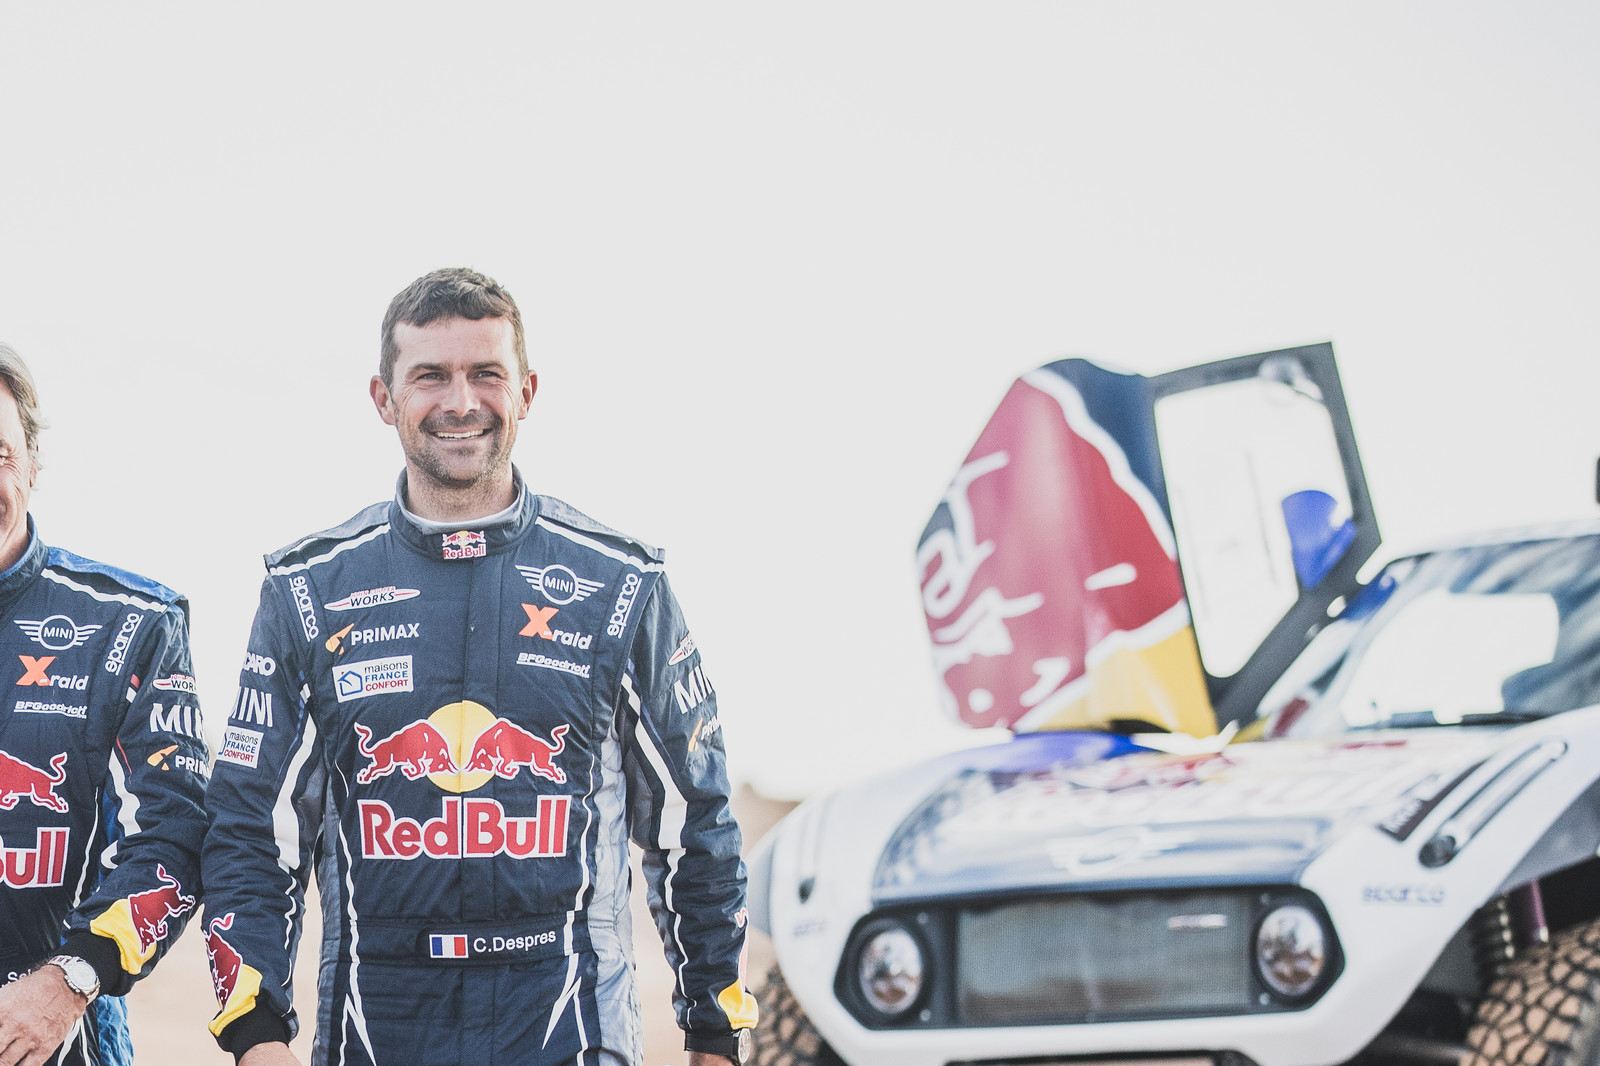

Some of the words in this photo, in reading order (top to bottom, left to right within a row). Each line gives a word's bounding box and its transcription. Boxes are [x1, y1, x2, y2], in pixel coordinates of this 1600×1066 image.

[443, 546, 463, 559] Red
[464, 544, 486, 557] Bull
[544, 576, 573, 593] MINI
[350, 592, 394, 607] WORKS
[607, 573, 641, 637] sparco
[291, 575, 319, 641] sparco
[43, 626, 73, 640] MINI
[351, 622, 420, 646] PRIMAX
[518, 603, 593, 650] X-raid
[105, 613, 142, 674] sparco
[16, 655, 89, 691] X-raid
[364, 661, 409, 673] maisons
[364, 670, 409, 682] FRANCE
[365, 679, 409, 692] CONFORT
[230, 686, 273, 727] INI
[229, 731, 259, 745] maisons
[226, 741, 256, 754] FRANCE
[223, 749, 254, 763] CONFORT
[357, 796, 462, 860] Red
[463, 795, 572, 858] Bull
